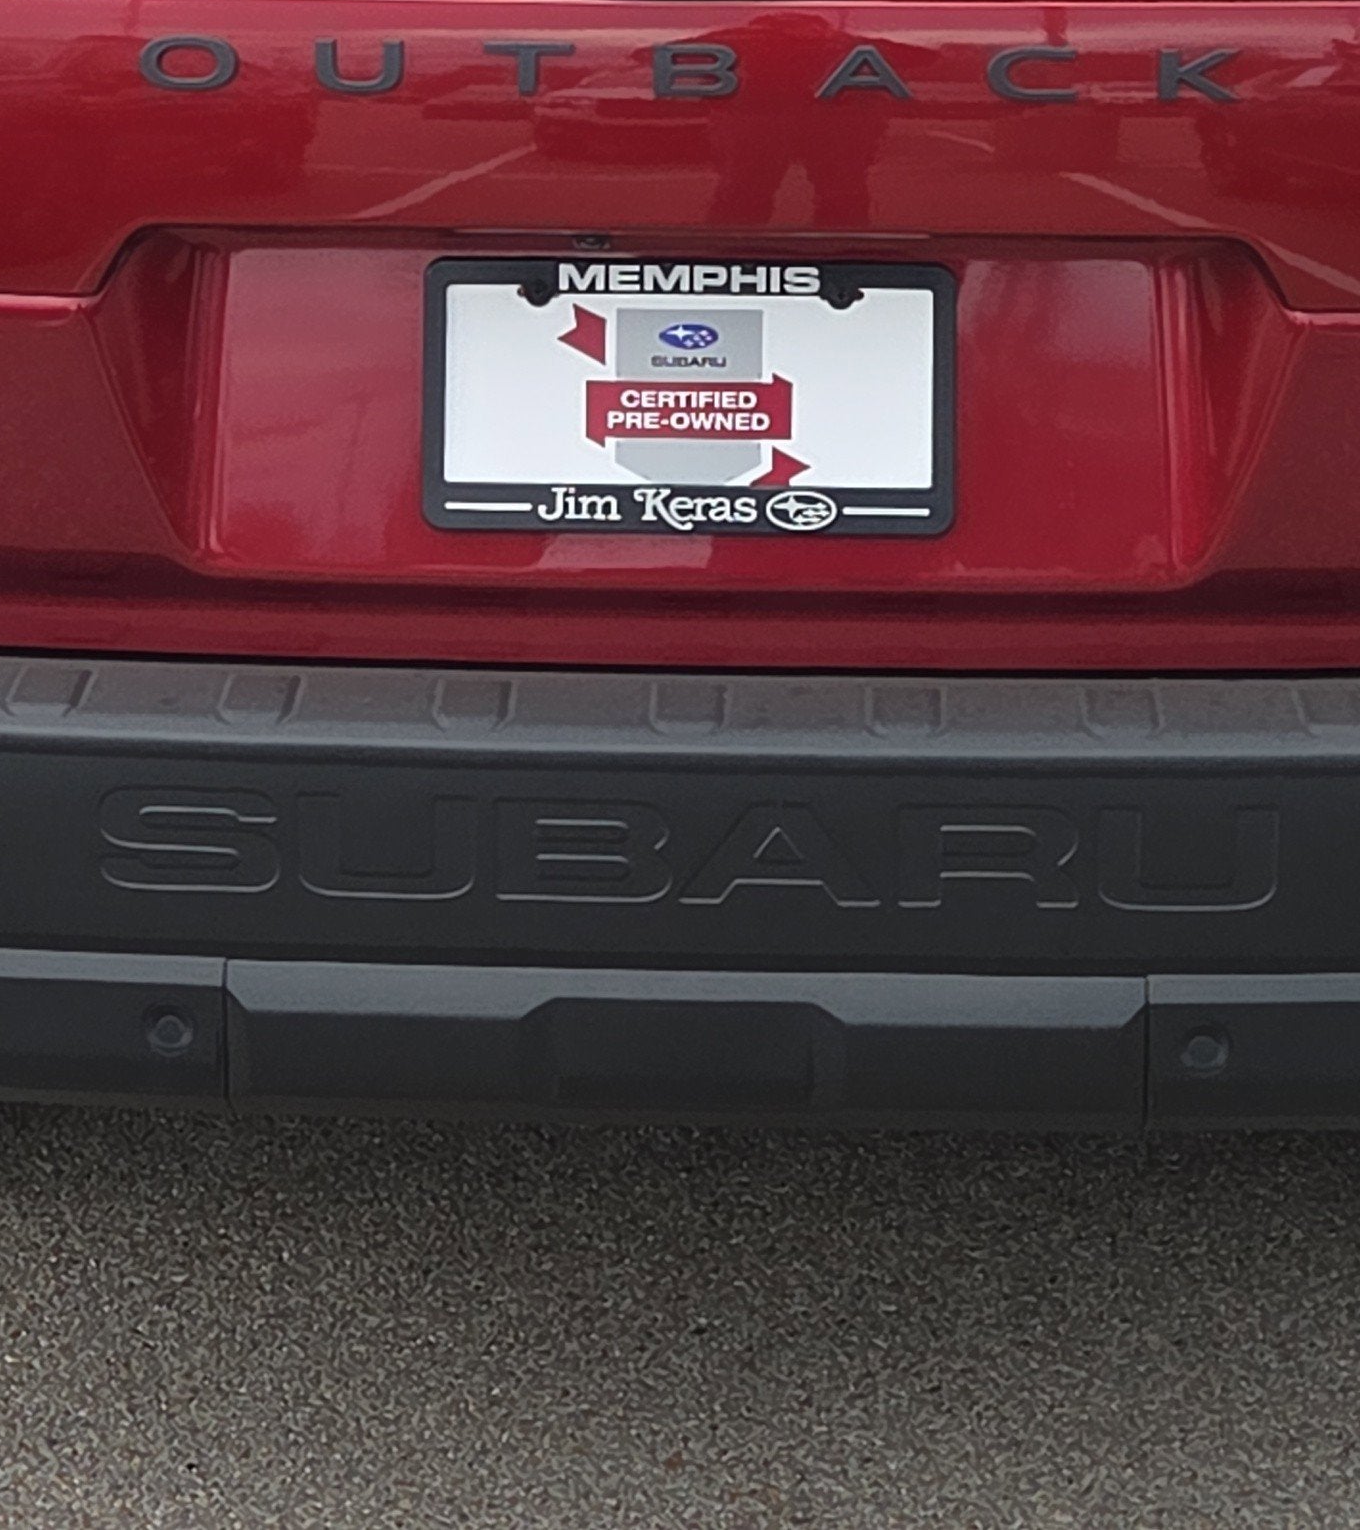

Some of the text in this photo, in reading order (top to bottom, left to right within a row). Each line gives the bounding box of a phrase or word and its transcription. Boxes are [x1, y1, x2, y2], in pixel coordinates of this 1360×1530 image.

[139, 33, 1240, 103] OUTBACK
[558, 263, 821, 295] MEMPHIS
[650, 354, 728, 369] SUBARU
[619, 388, 758, 410] CERTIFIED
[606, 411, 771, 432] PRE-OWNED
[537, 486, 758, 531] Jim Keras
[97, 783, 1282, 913] SUBARU
